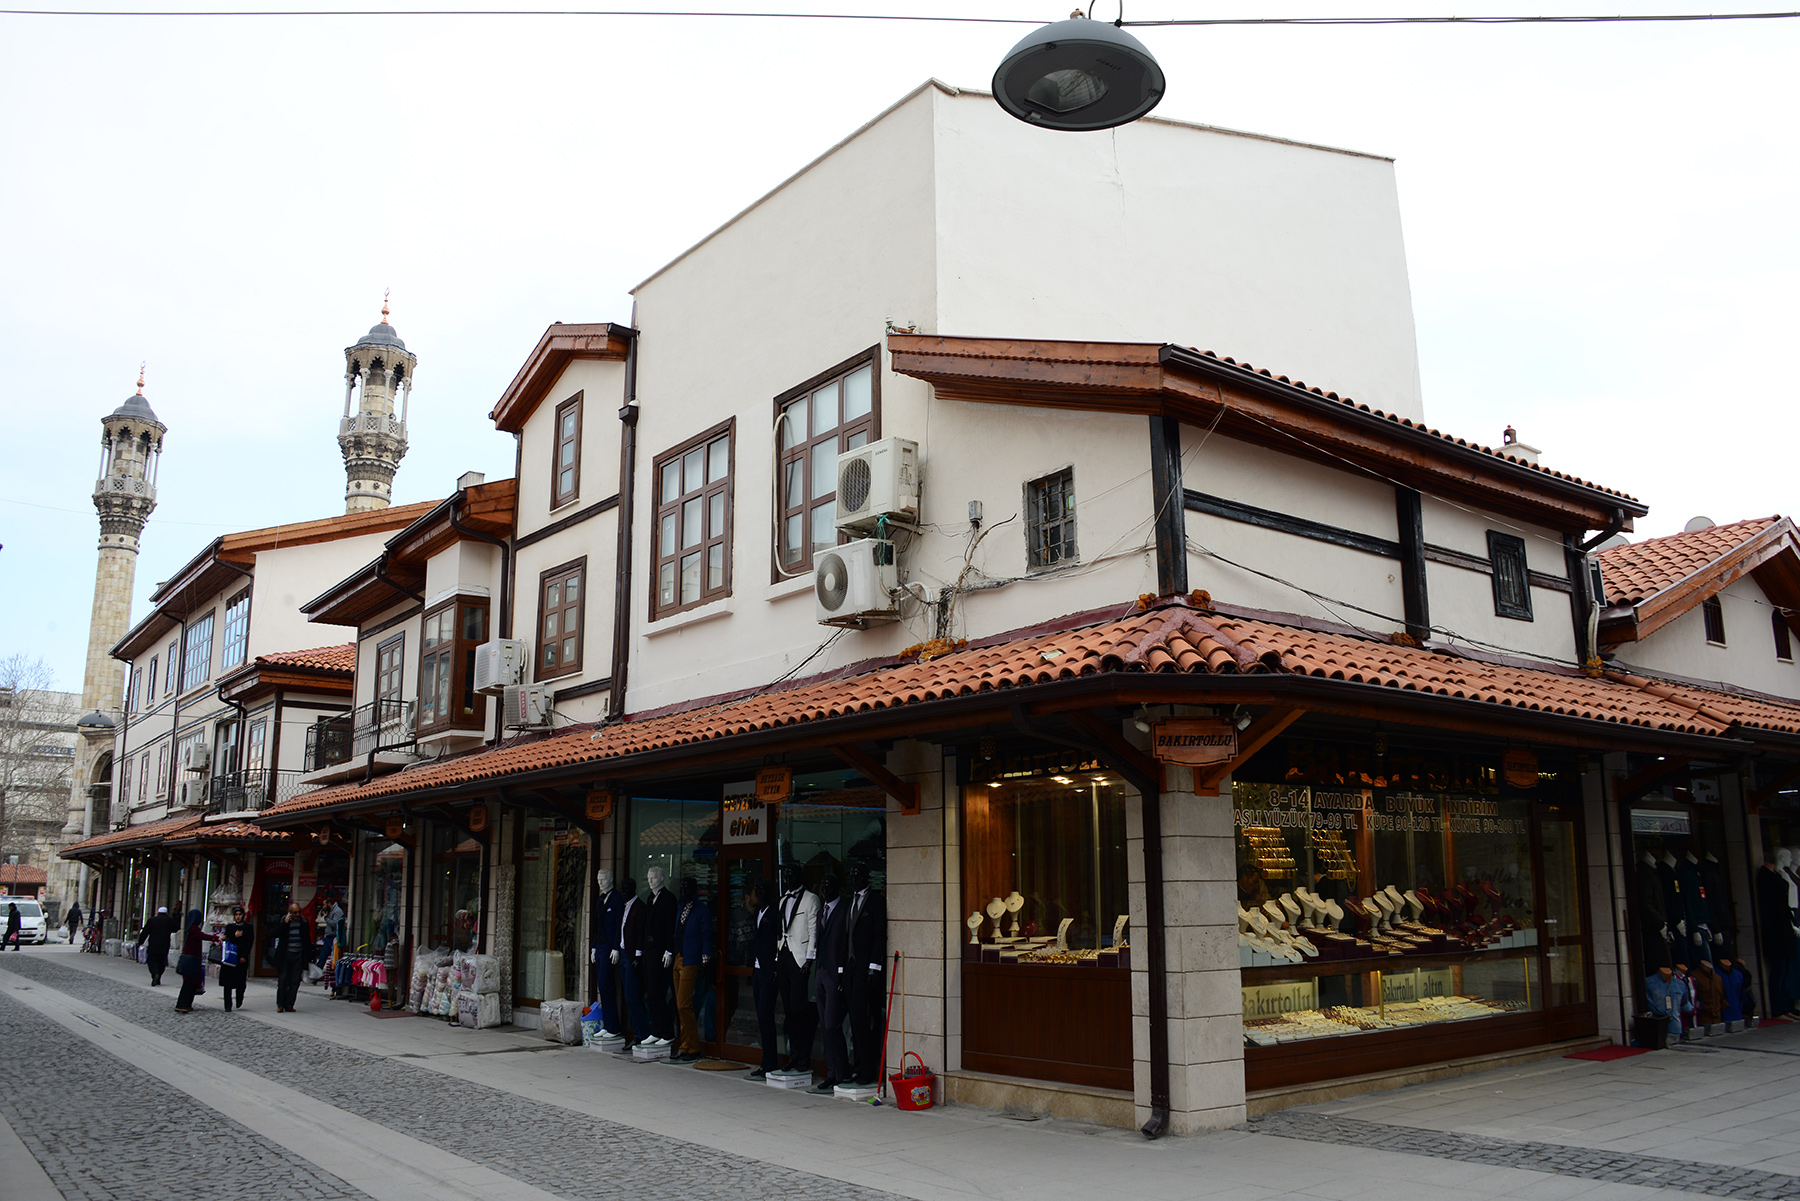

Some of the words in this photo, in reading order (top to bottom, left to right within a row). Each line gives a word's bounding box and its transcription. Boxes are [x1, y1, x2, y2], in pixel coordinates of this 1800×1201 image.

[1157, 734, 1232, 747] BAKIRTOLLU
[1269, 789, 1309, 808] 8-14
[1314, 791, 1375, 811] AYARDA
[1386, 793, 1436, 814] BÜYÜK
[1445, 796, 1498, 817] İNDİRİM
[730, 816, 759, 837] GİYİM
[1264, 808, 1308, 828] YÜZÜK
[1309, 812, 1342, 829] 79-99
[1344, 813, 1358, 830] TL
[1366, 811, 1394, 831] KÜPE
[1396, 815, 1431, 832] 90-120
[1432, 816, 1444, 832] TL
[1448, 814, 1481, 834] KÜNYE
[1483, 818, 1514, 834] 90-200
[1515, 819, 1527, 834] TL
[1423, 974, 1443, 998] altın
